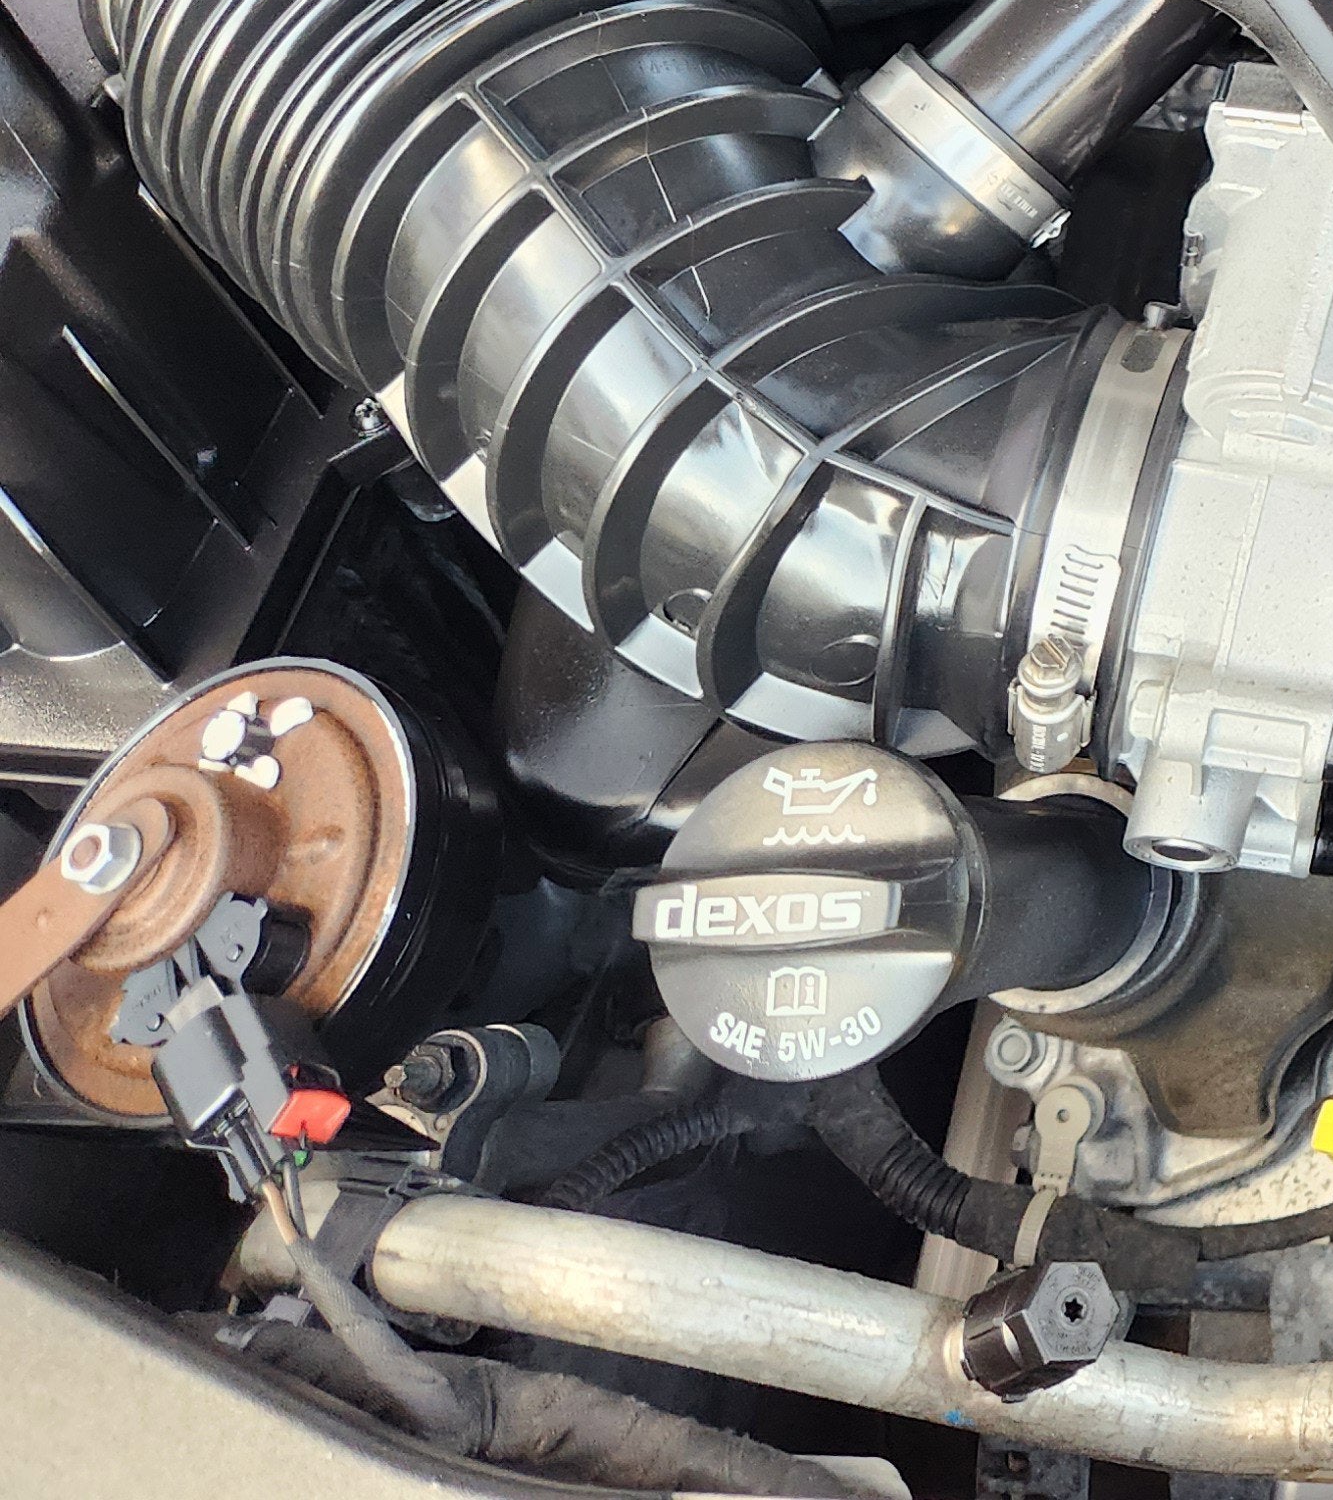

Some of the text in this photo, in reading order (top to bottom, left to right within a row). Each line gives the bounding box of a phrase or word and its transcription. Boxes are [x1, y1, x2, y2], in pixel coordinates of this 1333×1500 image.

[654, 884, 863, 939] dexos
[709, 1005, 882, 1063] SAE 5W-30
